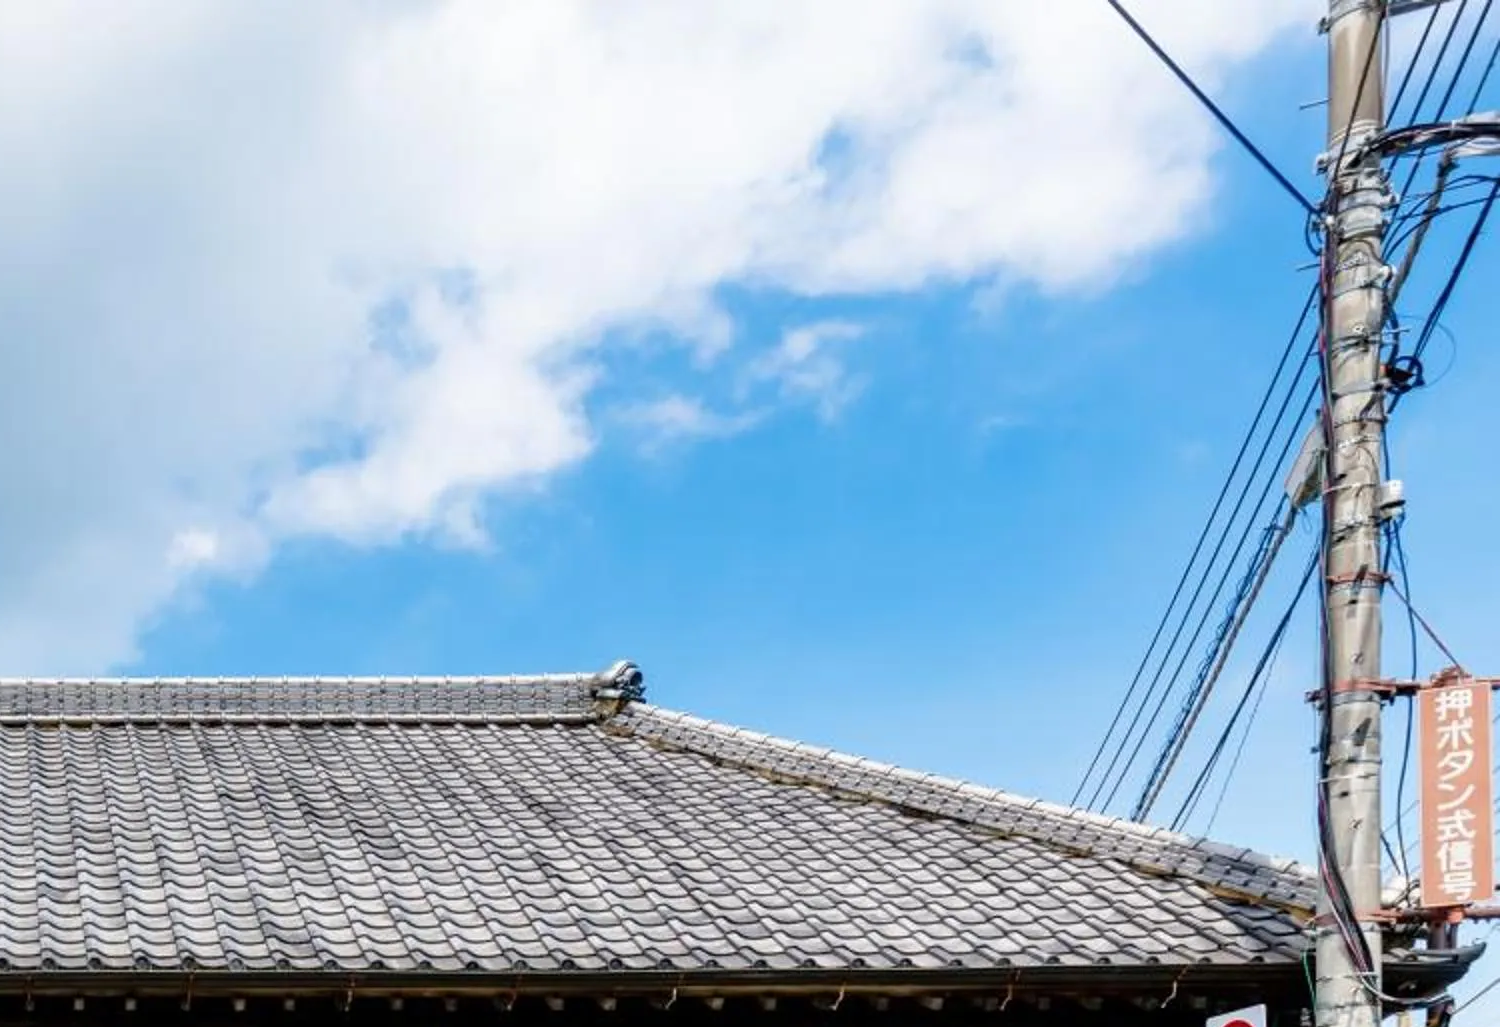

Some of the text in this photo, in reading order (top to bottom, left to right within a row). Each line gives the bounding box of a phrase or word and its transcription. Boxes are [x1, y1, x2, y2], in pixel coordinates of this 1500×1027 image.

[1435, 689, 1476, 901] 押ボタン式信号
